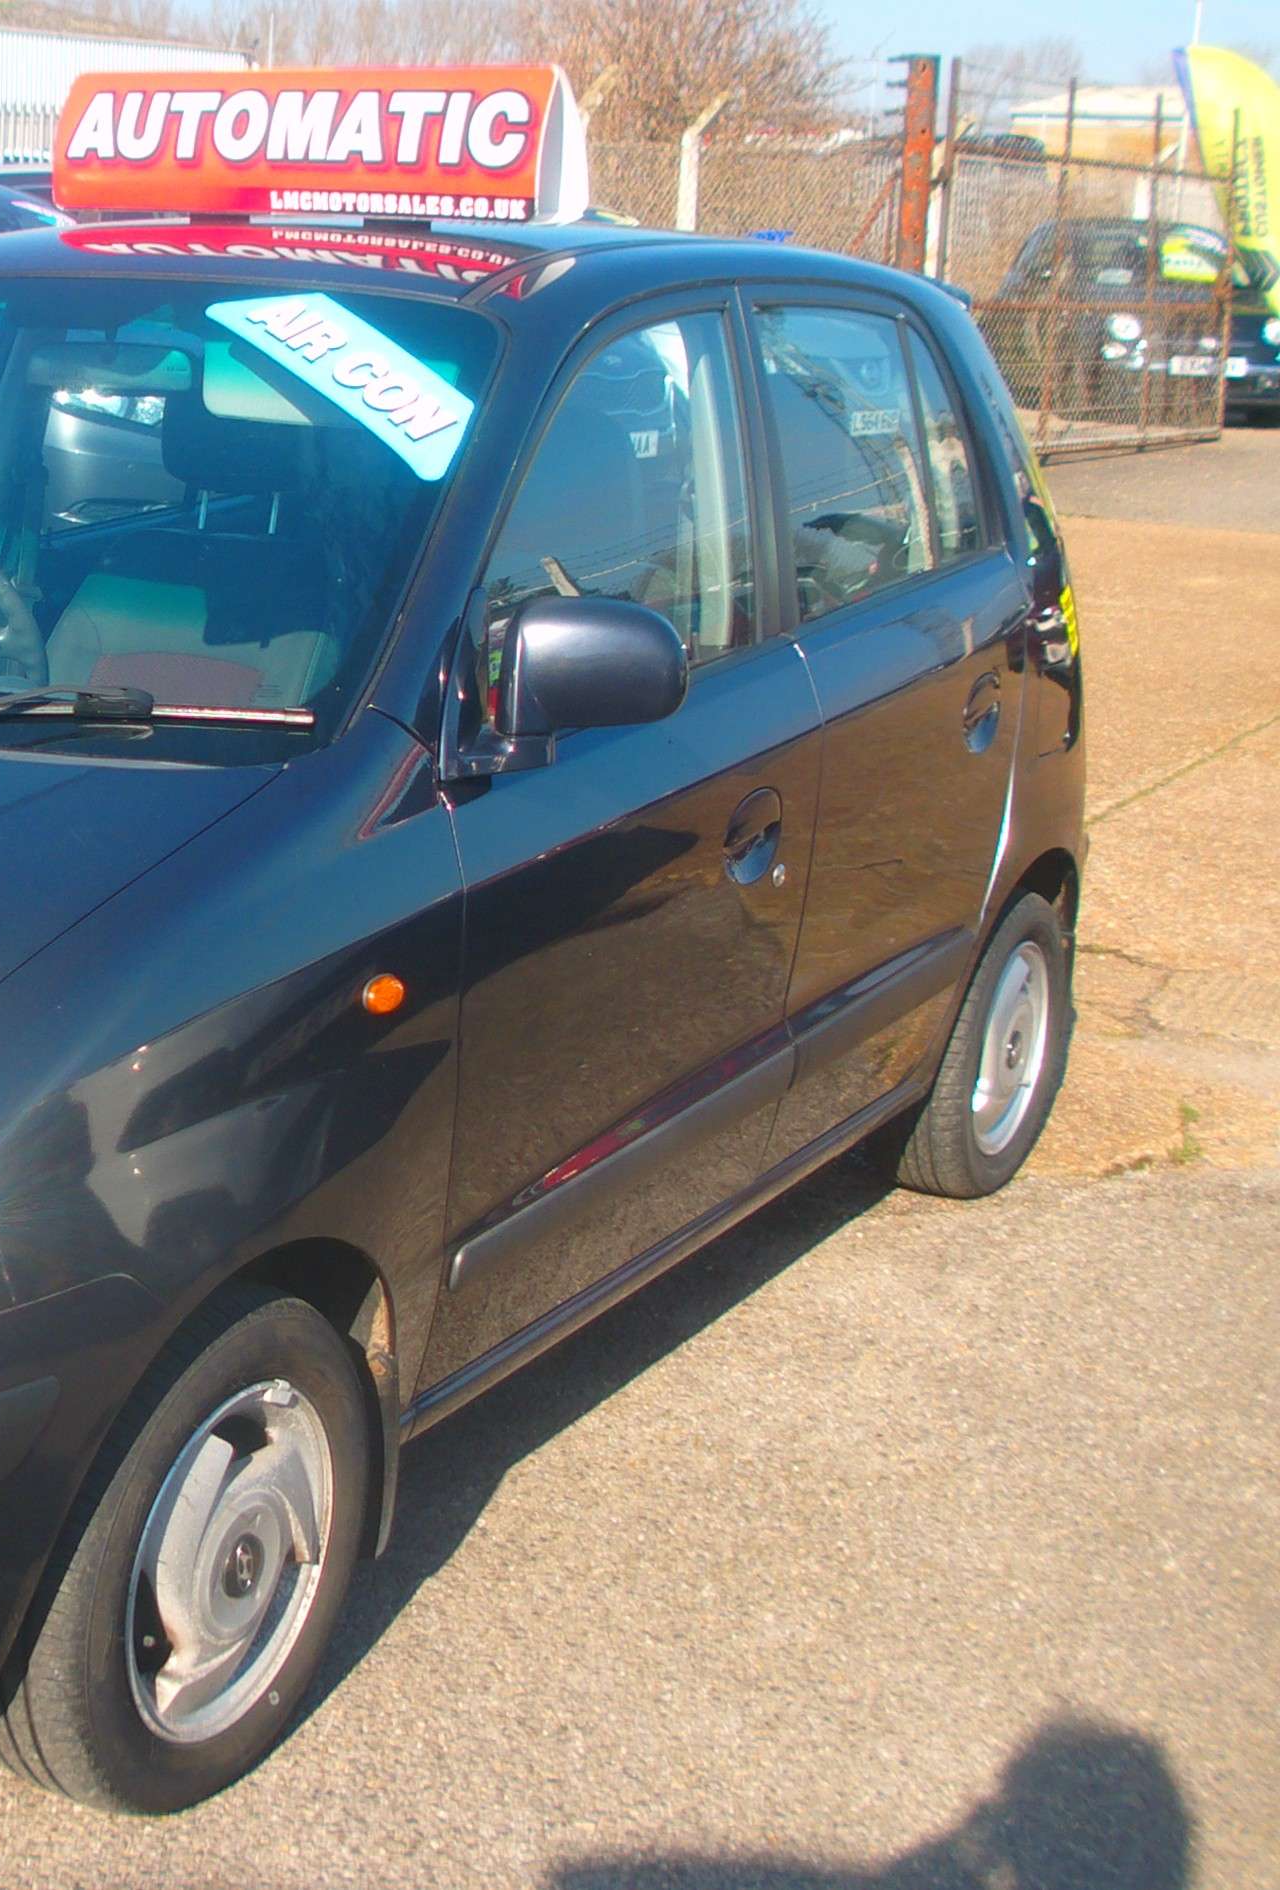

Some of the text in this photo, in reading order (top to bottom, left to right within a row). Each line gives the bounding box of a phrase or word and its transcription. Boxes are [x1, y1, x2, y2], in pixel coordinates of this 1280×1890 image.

[66, 90, 530, 168] AUTOMATIC
[270, 190, 526, 220] LMCMOTORSALES.CO.UK
[245, 298, 458, 442] AIR CON
